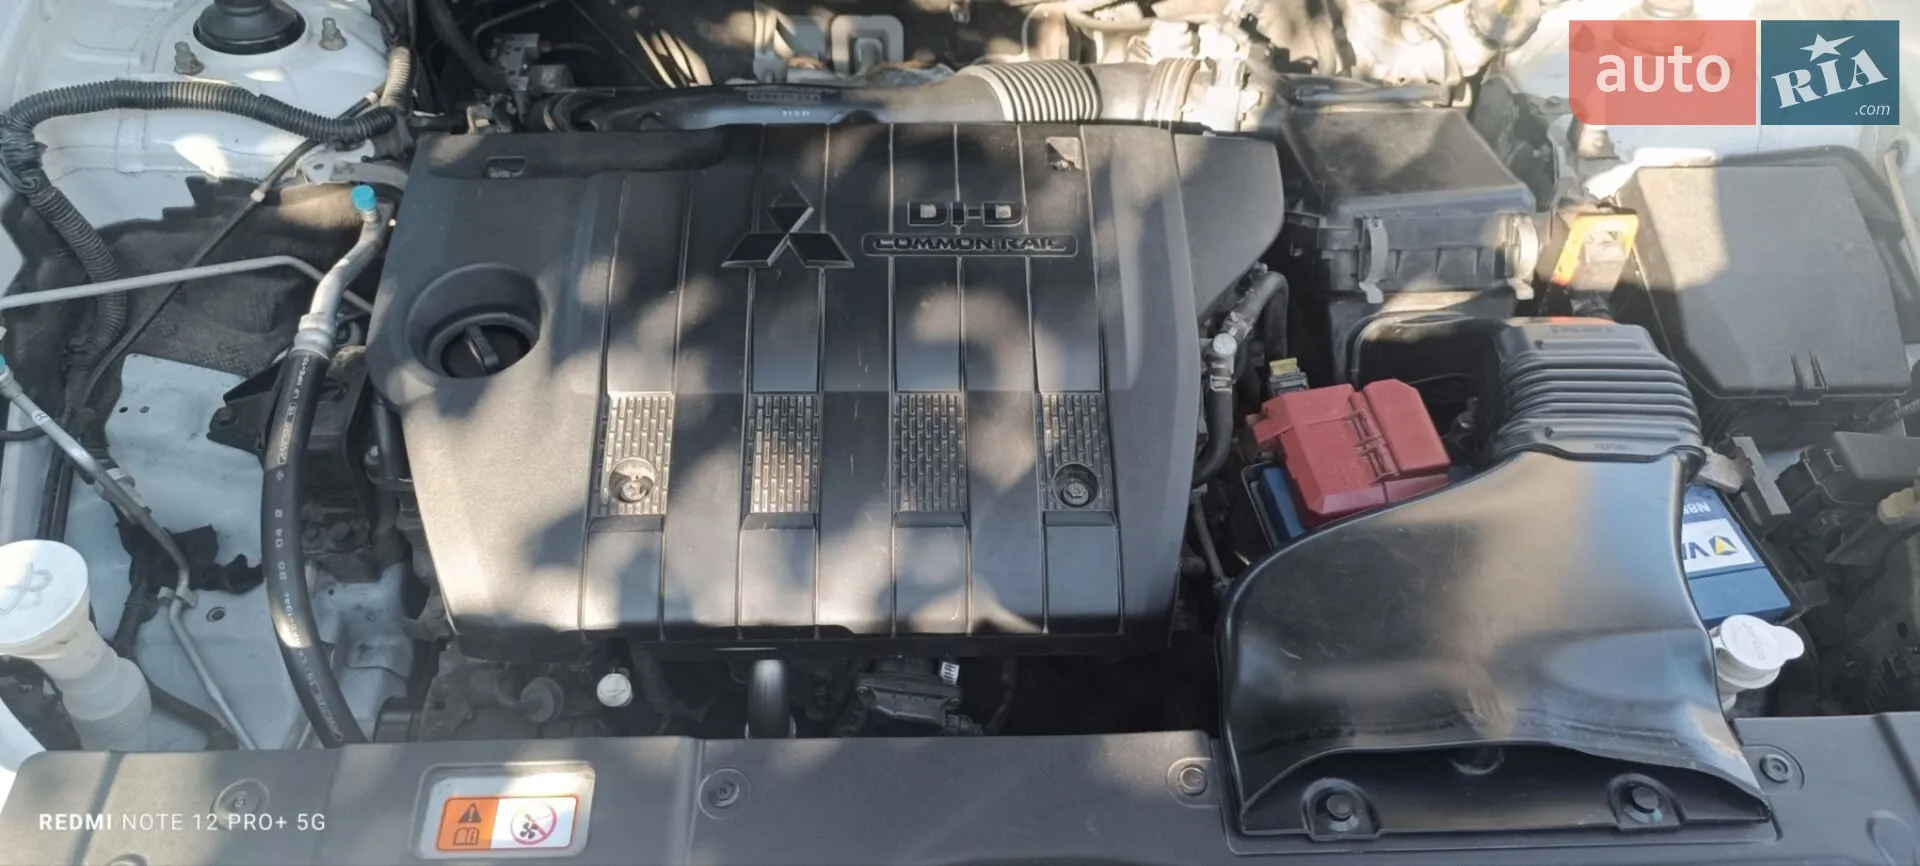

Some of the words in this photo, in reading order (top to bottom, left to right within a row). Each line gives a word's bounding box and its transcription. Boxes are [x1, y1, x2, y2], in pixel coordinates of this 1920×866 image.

[907, 201, 1025, 227] DI-D
[874, 236, 994, 251] COMMON
[1001, 236, 1066, 251] RAIL
